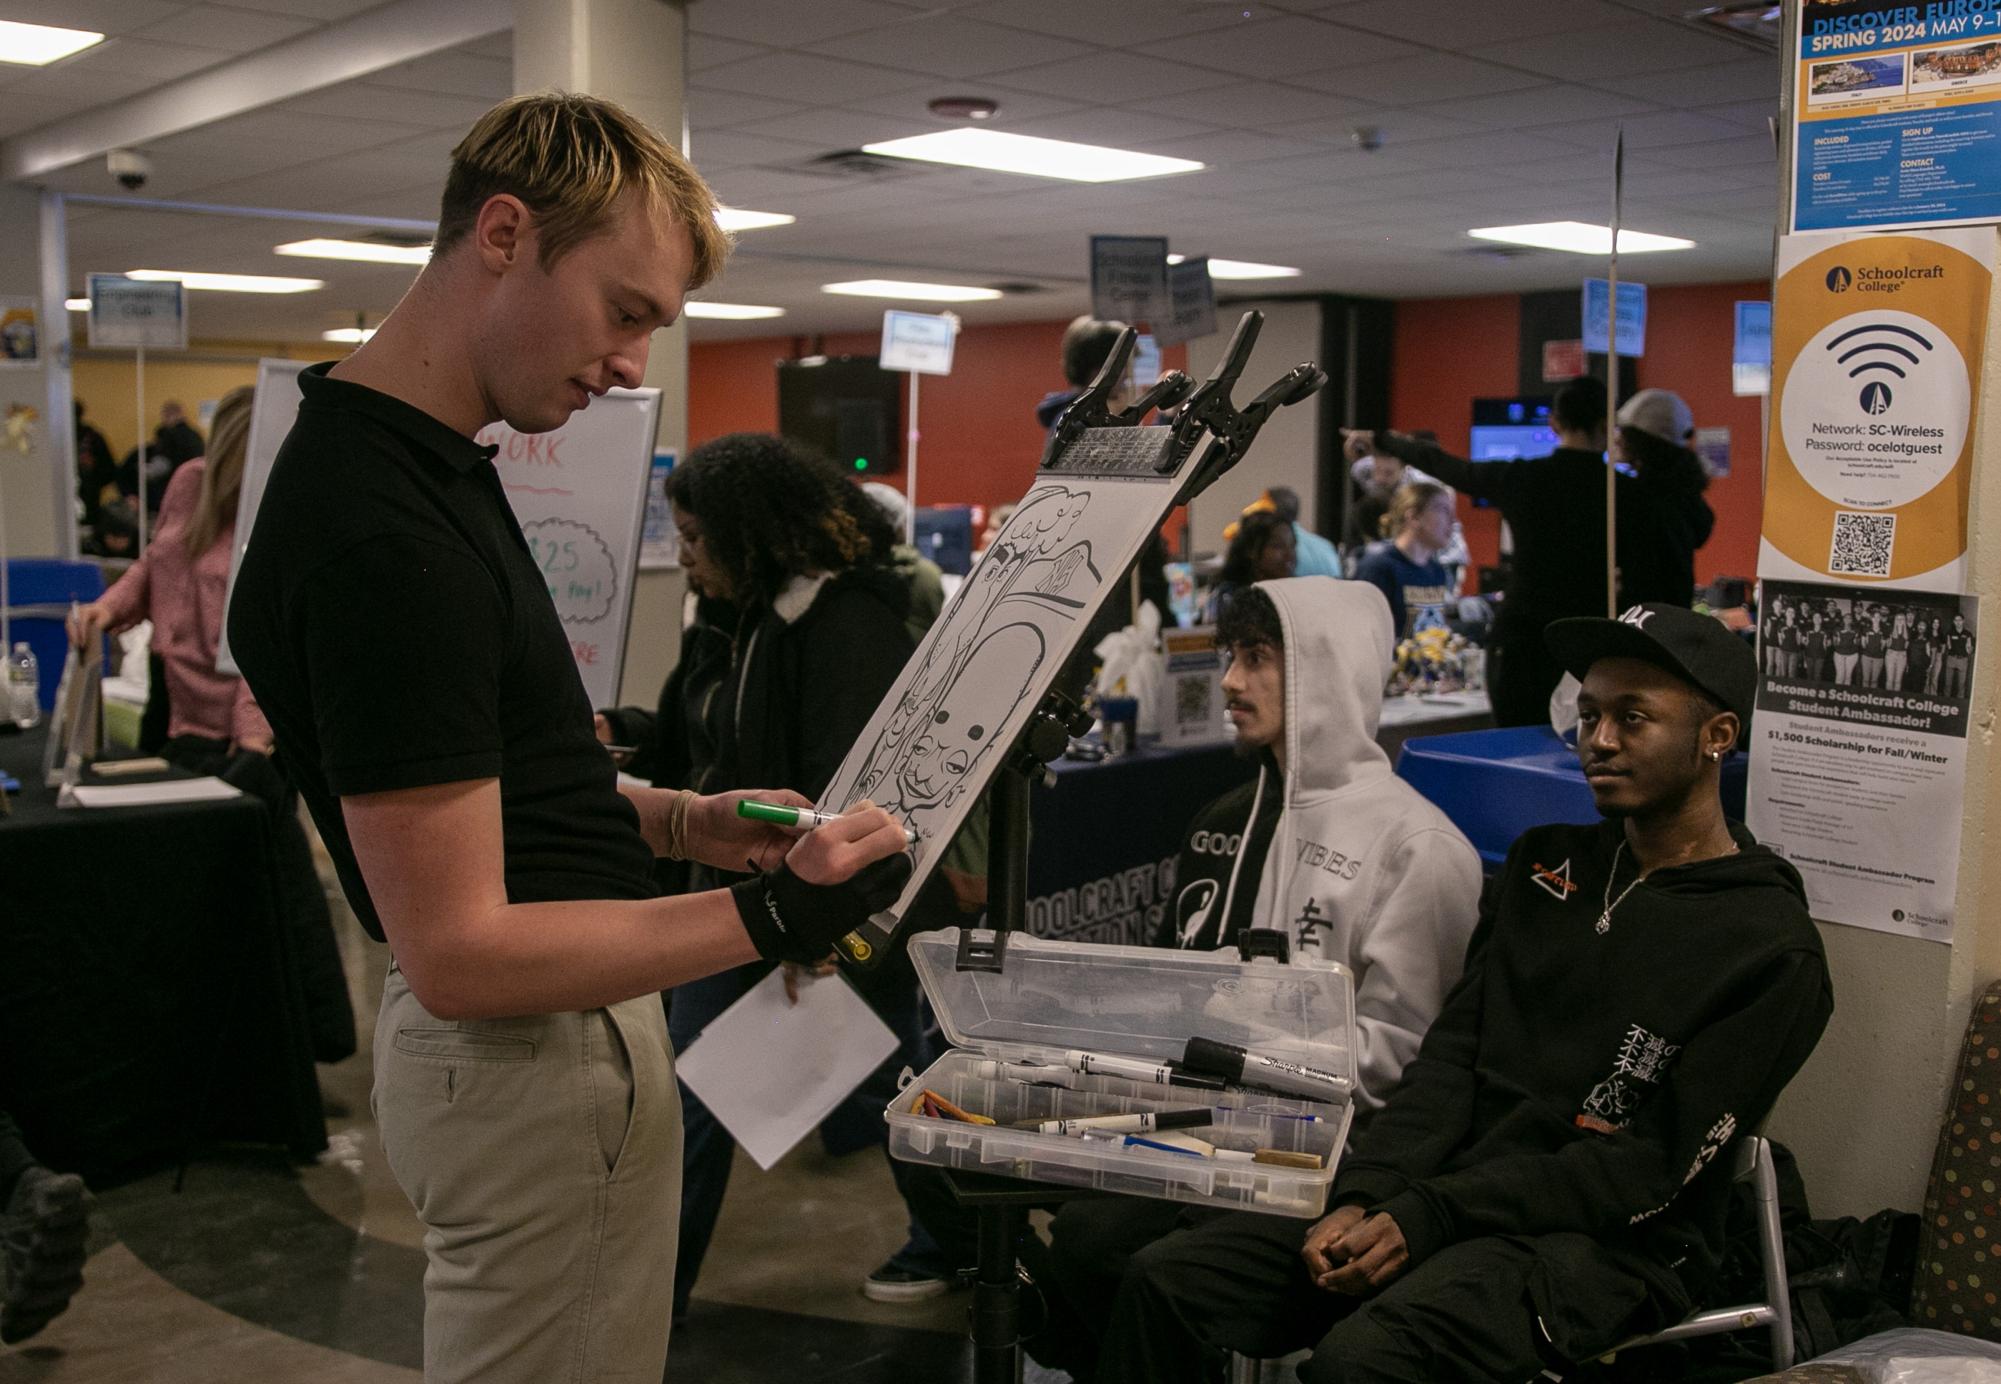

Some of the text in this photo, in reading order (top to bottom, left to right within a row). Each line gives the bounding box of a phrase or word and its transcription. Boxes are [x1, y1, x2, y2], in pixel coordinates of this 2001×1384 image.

[1814, 6, 1919, 35] DISCOVER
[1811, 30, 1876, 52] SPRING
[1882, 23, 1926, 43] 2024
[1931, 16, 1968, 36] MAY
[1814, 136, 1849, 146] INCLUDED
[1902, 127, 1933, 138] SIGN UP
[1900, 158, 1934, 169] CONTACT
[1812, 172, 1832, 182] COST
[1857, 265, 1944, 280] Schoolcraft
[1812, 422, 1944, 438] Network: SC-Wireless
[1806, 439, 1943, 455] Password: ocelotguest
[1767, 681, 1959, 716] Become a Schoolcraft College
[1788, 700, 1931, 730] Student Ambassador!
[1789, 721, 1823, 735] Student
[1825, 725, 1885, 743] Ambassadors
[1887, 734, 1917, 747] receive
[1768, 730, 1948, 765] $1,500 Scholarship for Fall/Winter
[1828, 860, 1856, 870] Student
[1903, 872, 1935, 885] Program
[1260, 1057, 1304, 1074] Sharpie
